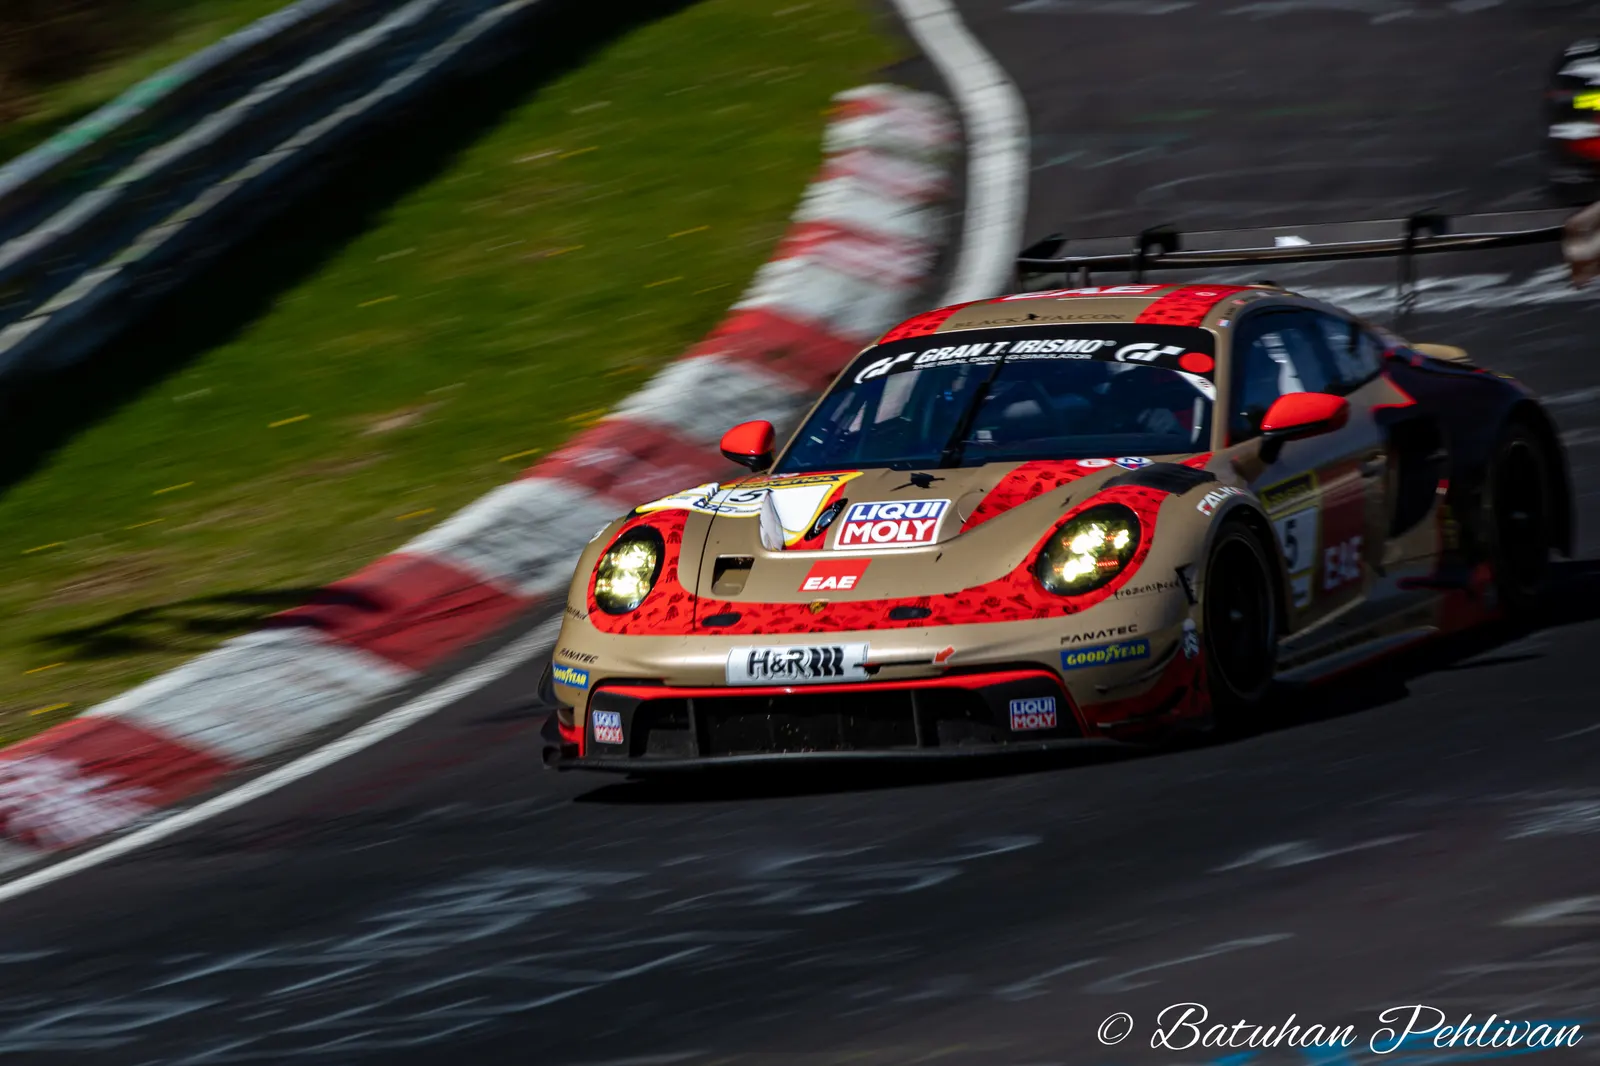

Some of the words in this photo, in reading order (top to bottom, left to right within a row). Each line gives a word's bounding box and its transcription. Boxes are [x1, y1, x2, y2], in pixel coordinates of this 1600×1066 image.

[1039, 313, 1124, 322] FALCON
[914, 342, 992, 364] GRAN
[912, 362, 937, 370] THE
[851, 502, 942, 521] LIQUI
[843, 519, 937, 543] MOLY
[1323, 535, 1364, 590] EAE
[802, 575, 857, 590] EAE
[1060, 624, 1138, 645] FANATEC
[558, 647, 599, 665] FANATEC
[1067, 644, 1146, 665] GOODYEAR
[1013, 697, 1054, 714] LIQUI
[1014, 712, 1055, 729] MOLY
